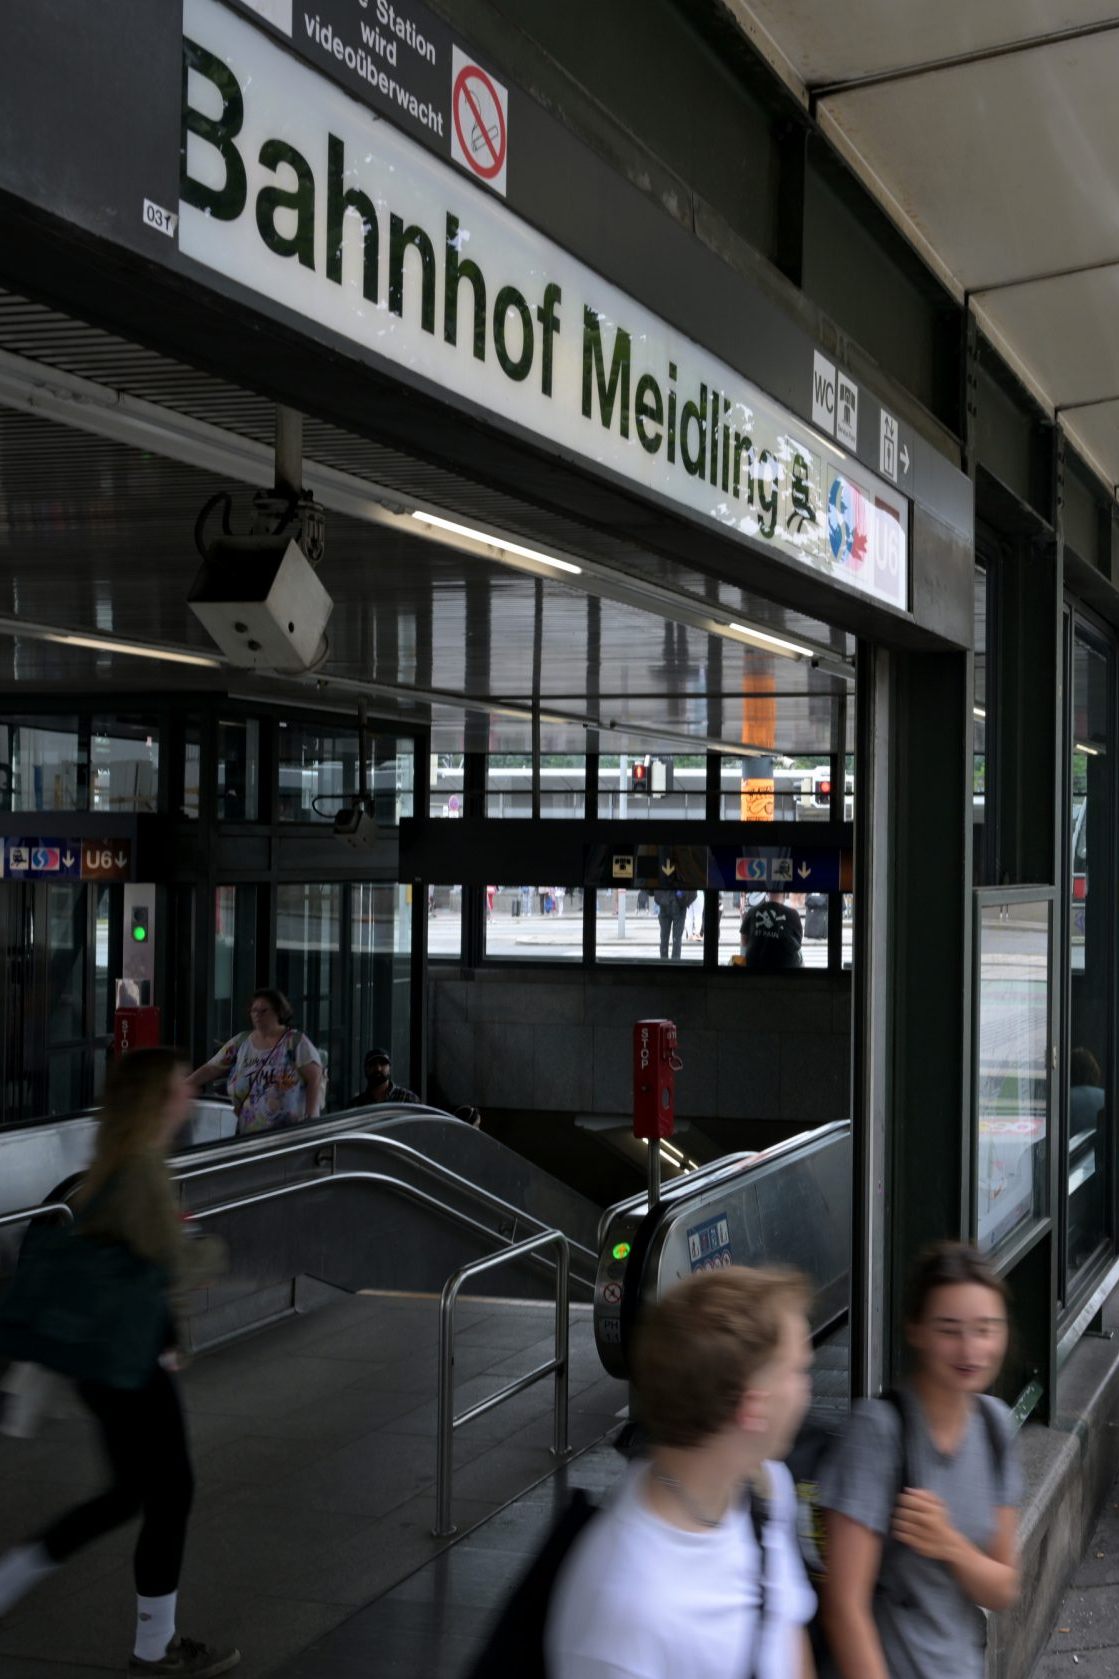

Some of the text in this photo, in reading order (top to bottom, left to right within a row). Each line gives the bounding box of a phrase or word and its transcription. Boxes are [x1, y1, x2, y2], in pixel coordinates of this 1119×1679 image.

[360, 21, 397, 67] wird
[377, 0, 436, 66] Station
[304, 13, 444, 137] videoüberwacht
[180, 35, 781, 540] Bahnhof Meidling
[814, 371, 834, 414] WC
[876, 523, 899, 577] U6
[86, 849, 113, 869] U6
[640, 1027, 650, 1071] STOP
